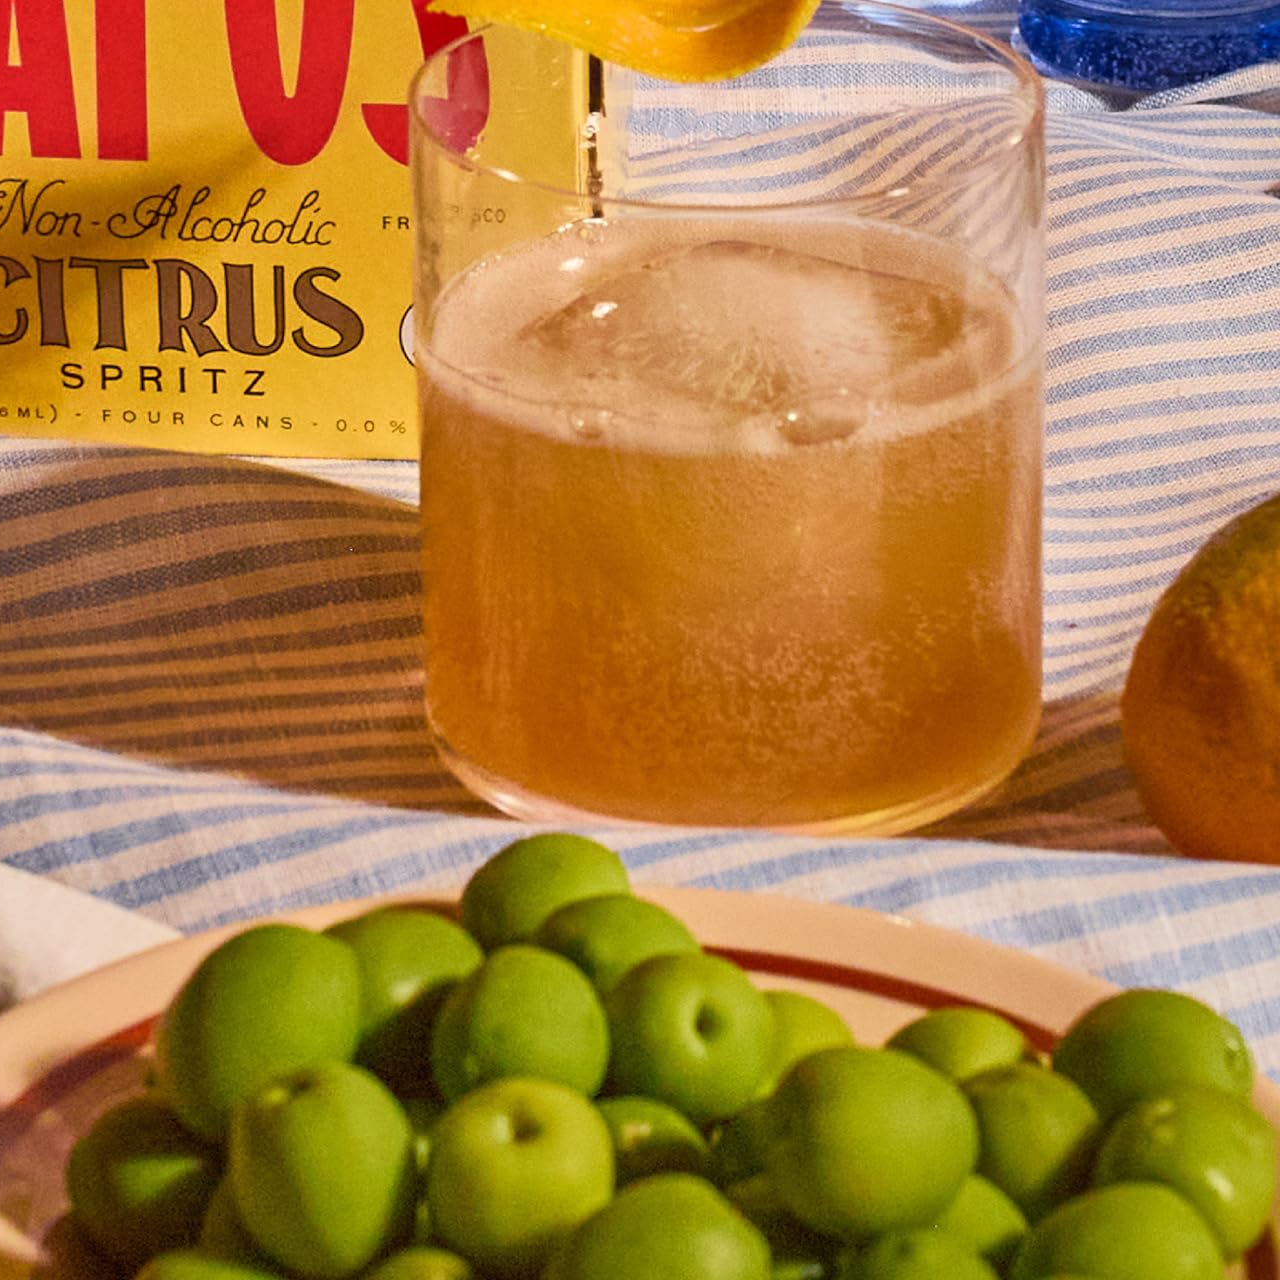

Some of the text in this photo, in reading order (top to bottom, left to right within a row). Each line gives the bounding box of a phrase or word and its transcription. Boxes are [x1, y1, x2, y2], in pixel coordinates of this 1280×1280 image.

[60, 364, 266, 396] SPRITZ
[102, 409, 184, 425] FOUR
[210, 413, 292, 430] CANS
